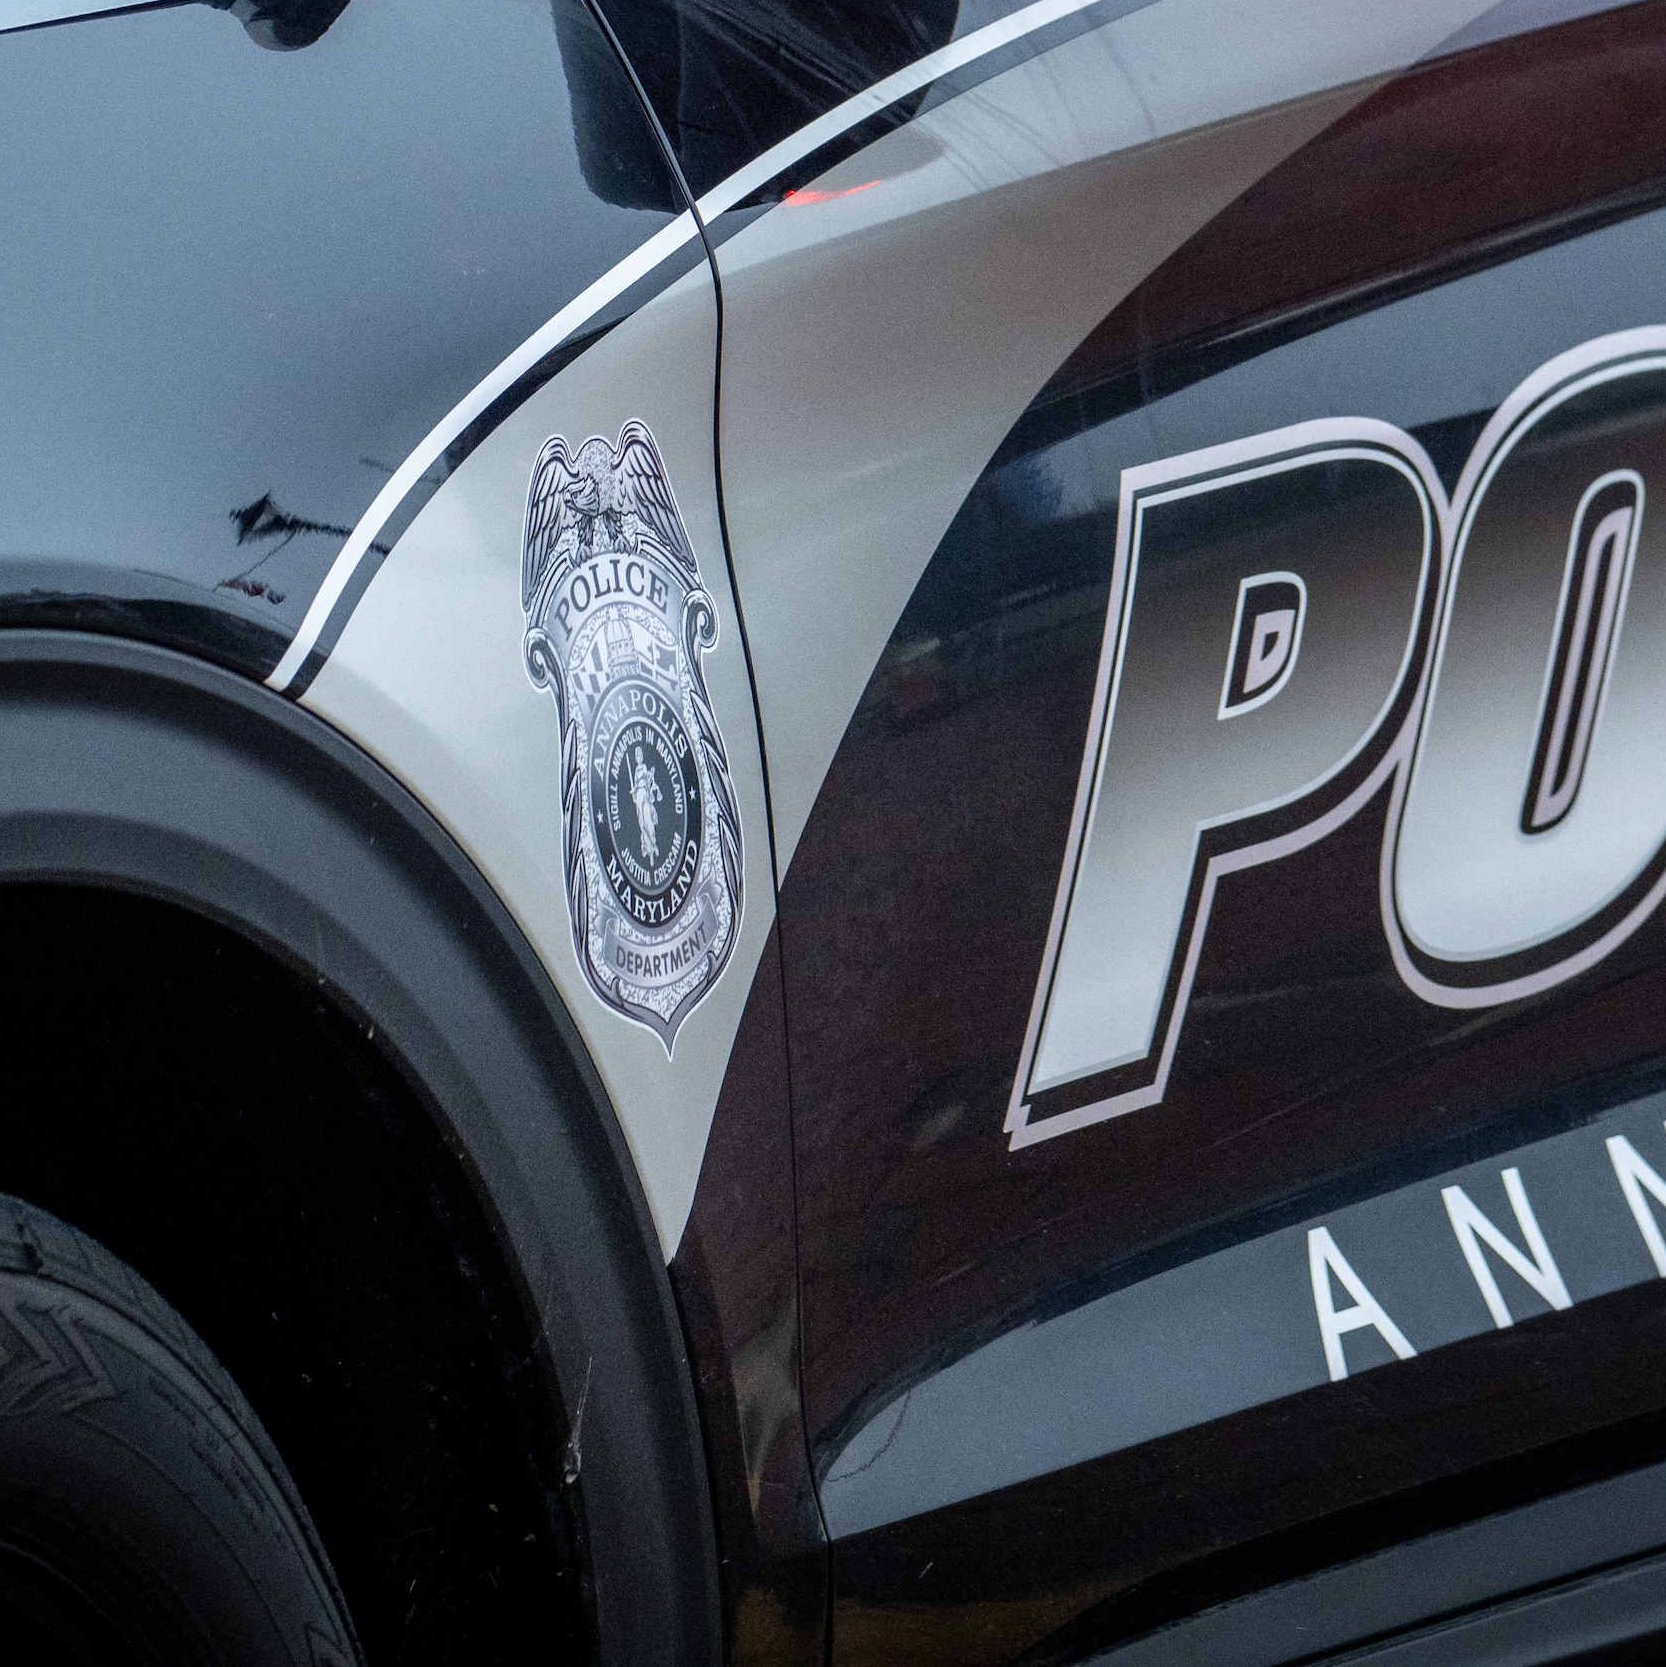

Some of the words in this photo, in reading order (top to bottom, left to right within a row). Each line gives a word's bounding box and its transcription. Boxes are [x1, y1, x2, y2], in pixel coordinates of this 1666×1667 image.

[554, 559, 669, 642] POLICE
[594, 689, 688, 781] ANNAPOLIS
[611, 726, 643, 780] ANNAPOLIS
[645, 728, 655, 746] IN
[656, 737, 684, 814] MARYLAND
[606, 839, 698, 923] MARYLAND
[621, 847, 652, 886] JUSTITIA
[653, 831, 682, 885] CRESCAM
[616, 921, 708, 978] DEPARTMENT
